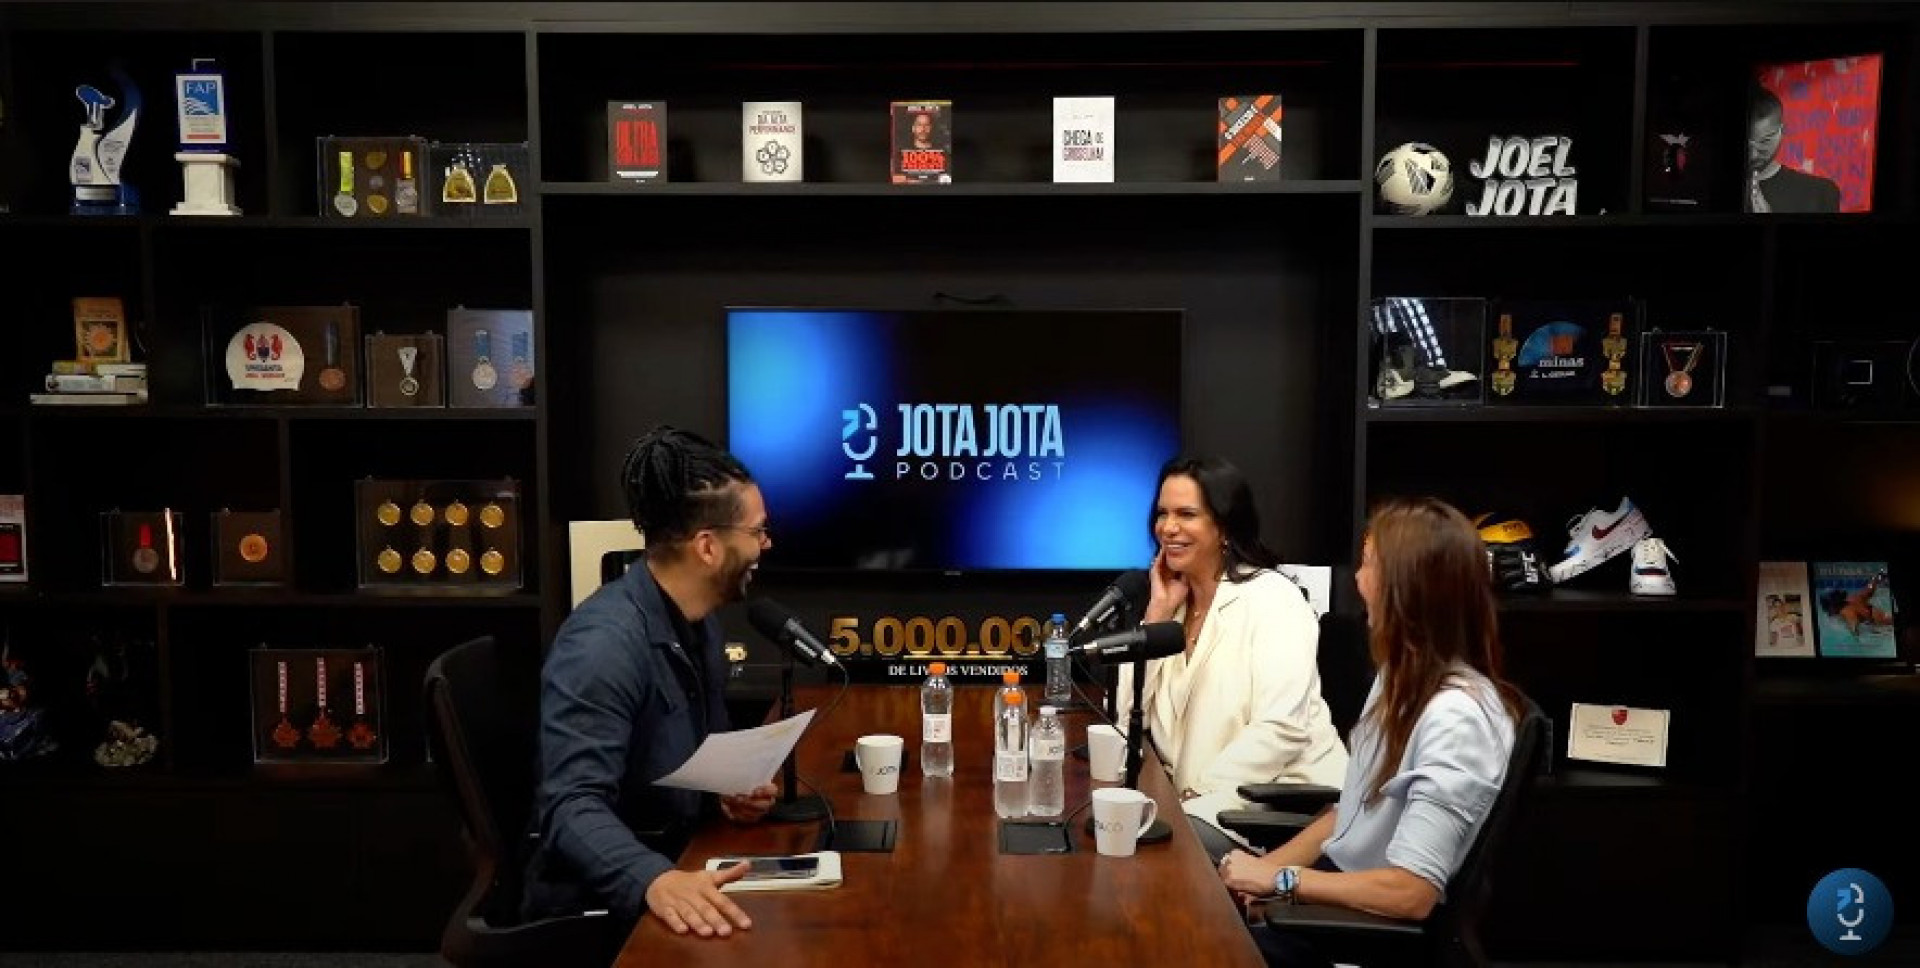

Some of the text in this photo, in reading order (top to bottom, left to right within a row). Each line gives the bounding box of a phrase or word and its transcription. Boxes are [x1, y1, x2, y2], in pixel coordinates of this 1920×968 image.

[186, 82, 217, 95] FAP
[1470, 136, 1576, 179] JOEL
[1466, 178, 1578, 216] JOTA
[896, 462, 1065, 480] PODCAST
